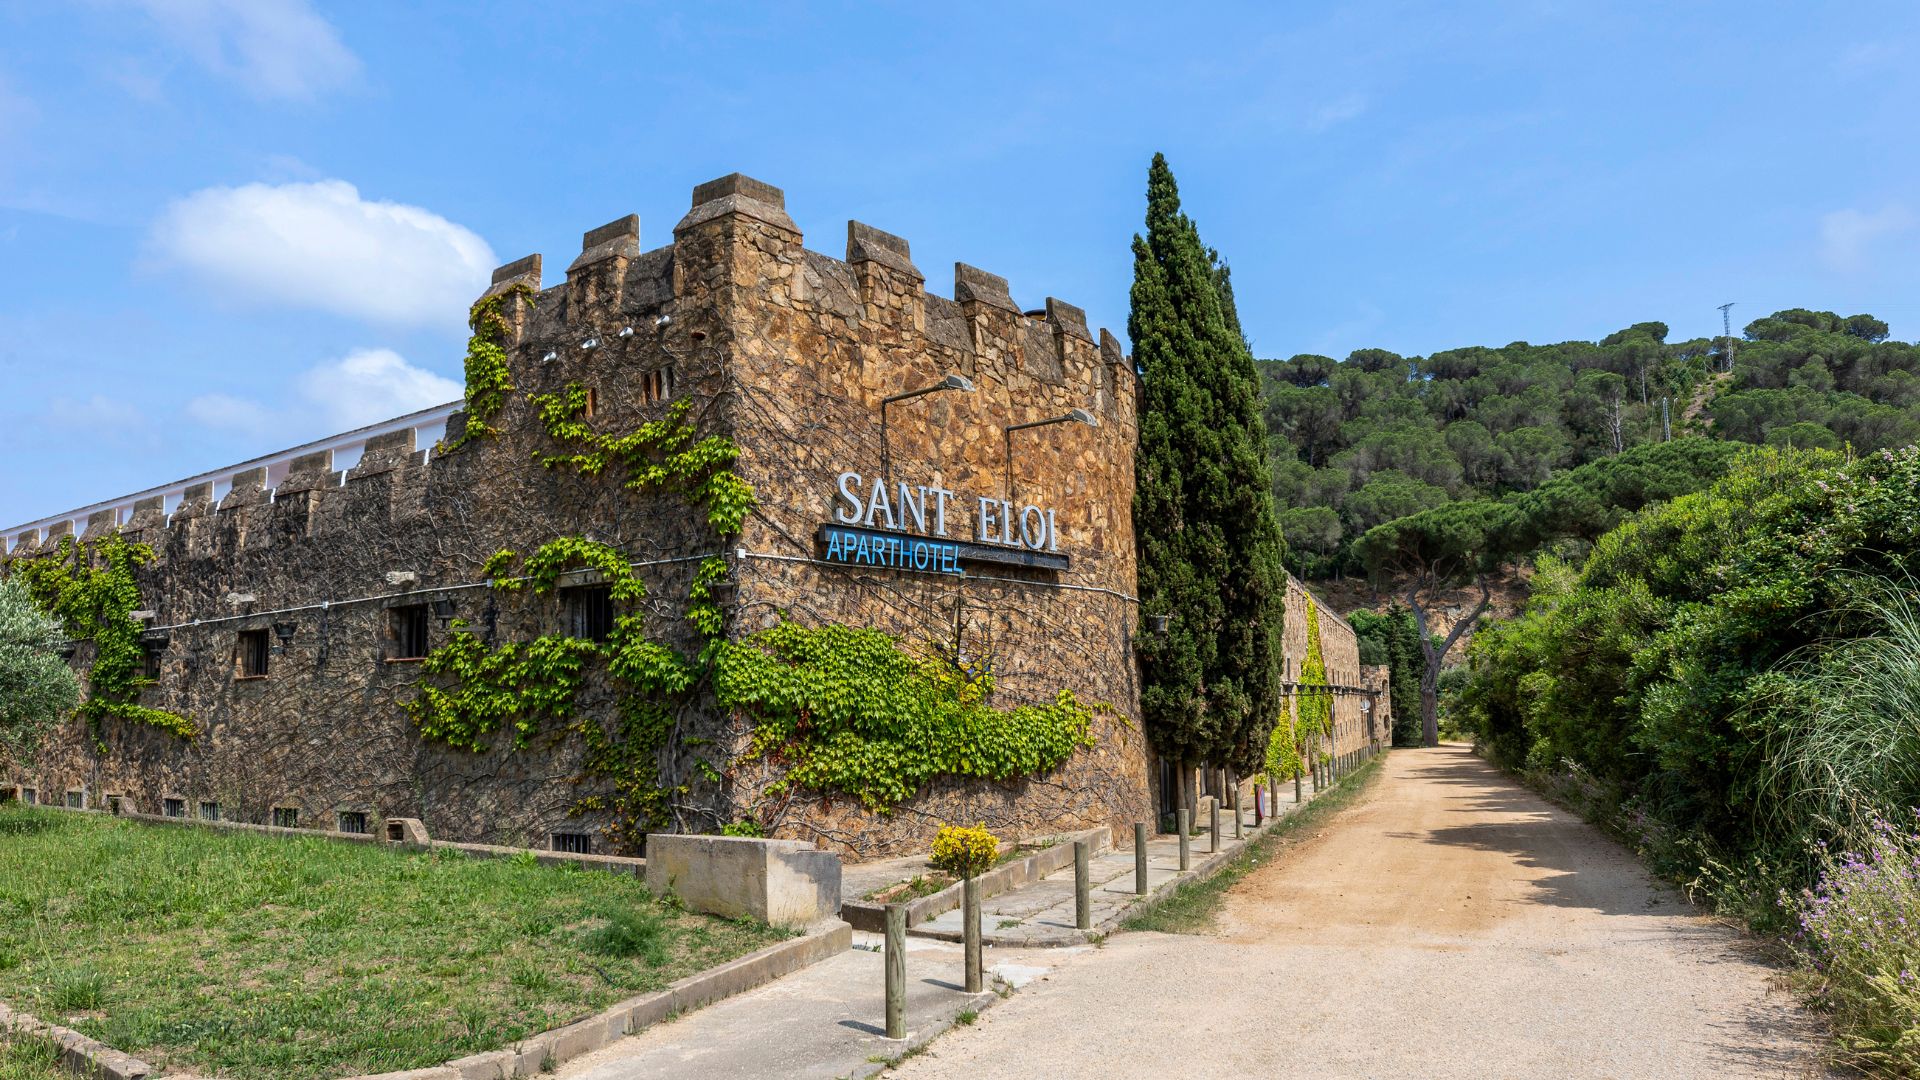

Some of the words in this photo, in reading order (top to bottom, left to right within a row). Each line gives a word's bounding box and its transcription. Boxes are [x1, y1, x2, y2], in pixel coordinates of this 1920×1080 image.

[836, 472, 953, 536] SANT
[979, 497, 1058, 551] ELOI
[826, 531, 963, 573] APARTHOTEL
